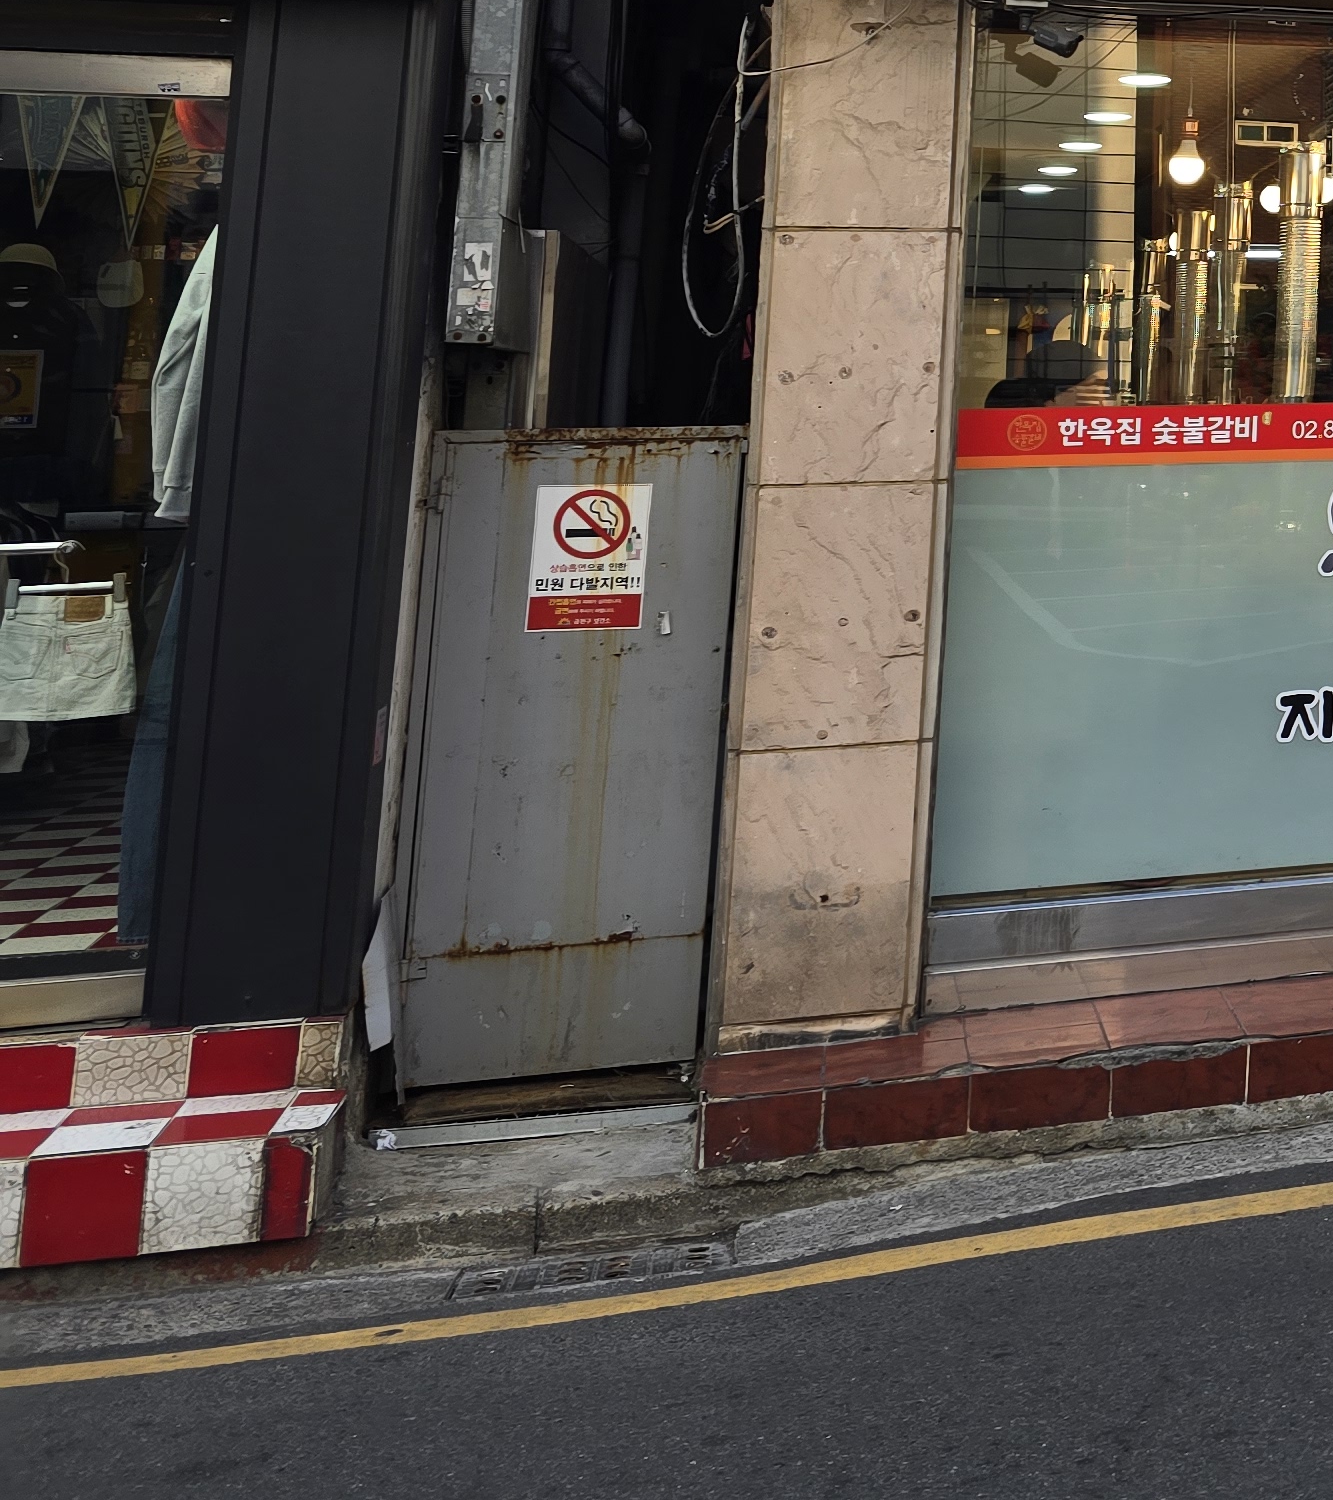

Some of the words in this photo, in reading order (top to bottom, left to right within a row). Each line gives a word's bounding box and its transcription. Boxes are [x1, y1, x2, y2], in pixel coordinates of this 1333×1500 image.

[1058, 417, 1141, 447] 한옥집
[1151, 414, 1259, 446] 숯불갈비
[608, 562, 627, 572] 인한
[535, 577, 564, 591] 민원
[570, 576, 641, 590] 다발지역!!
